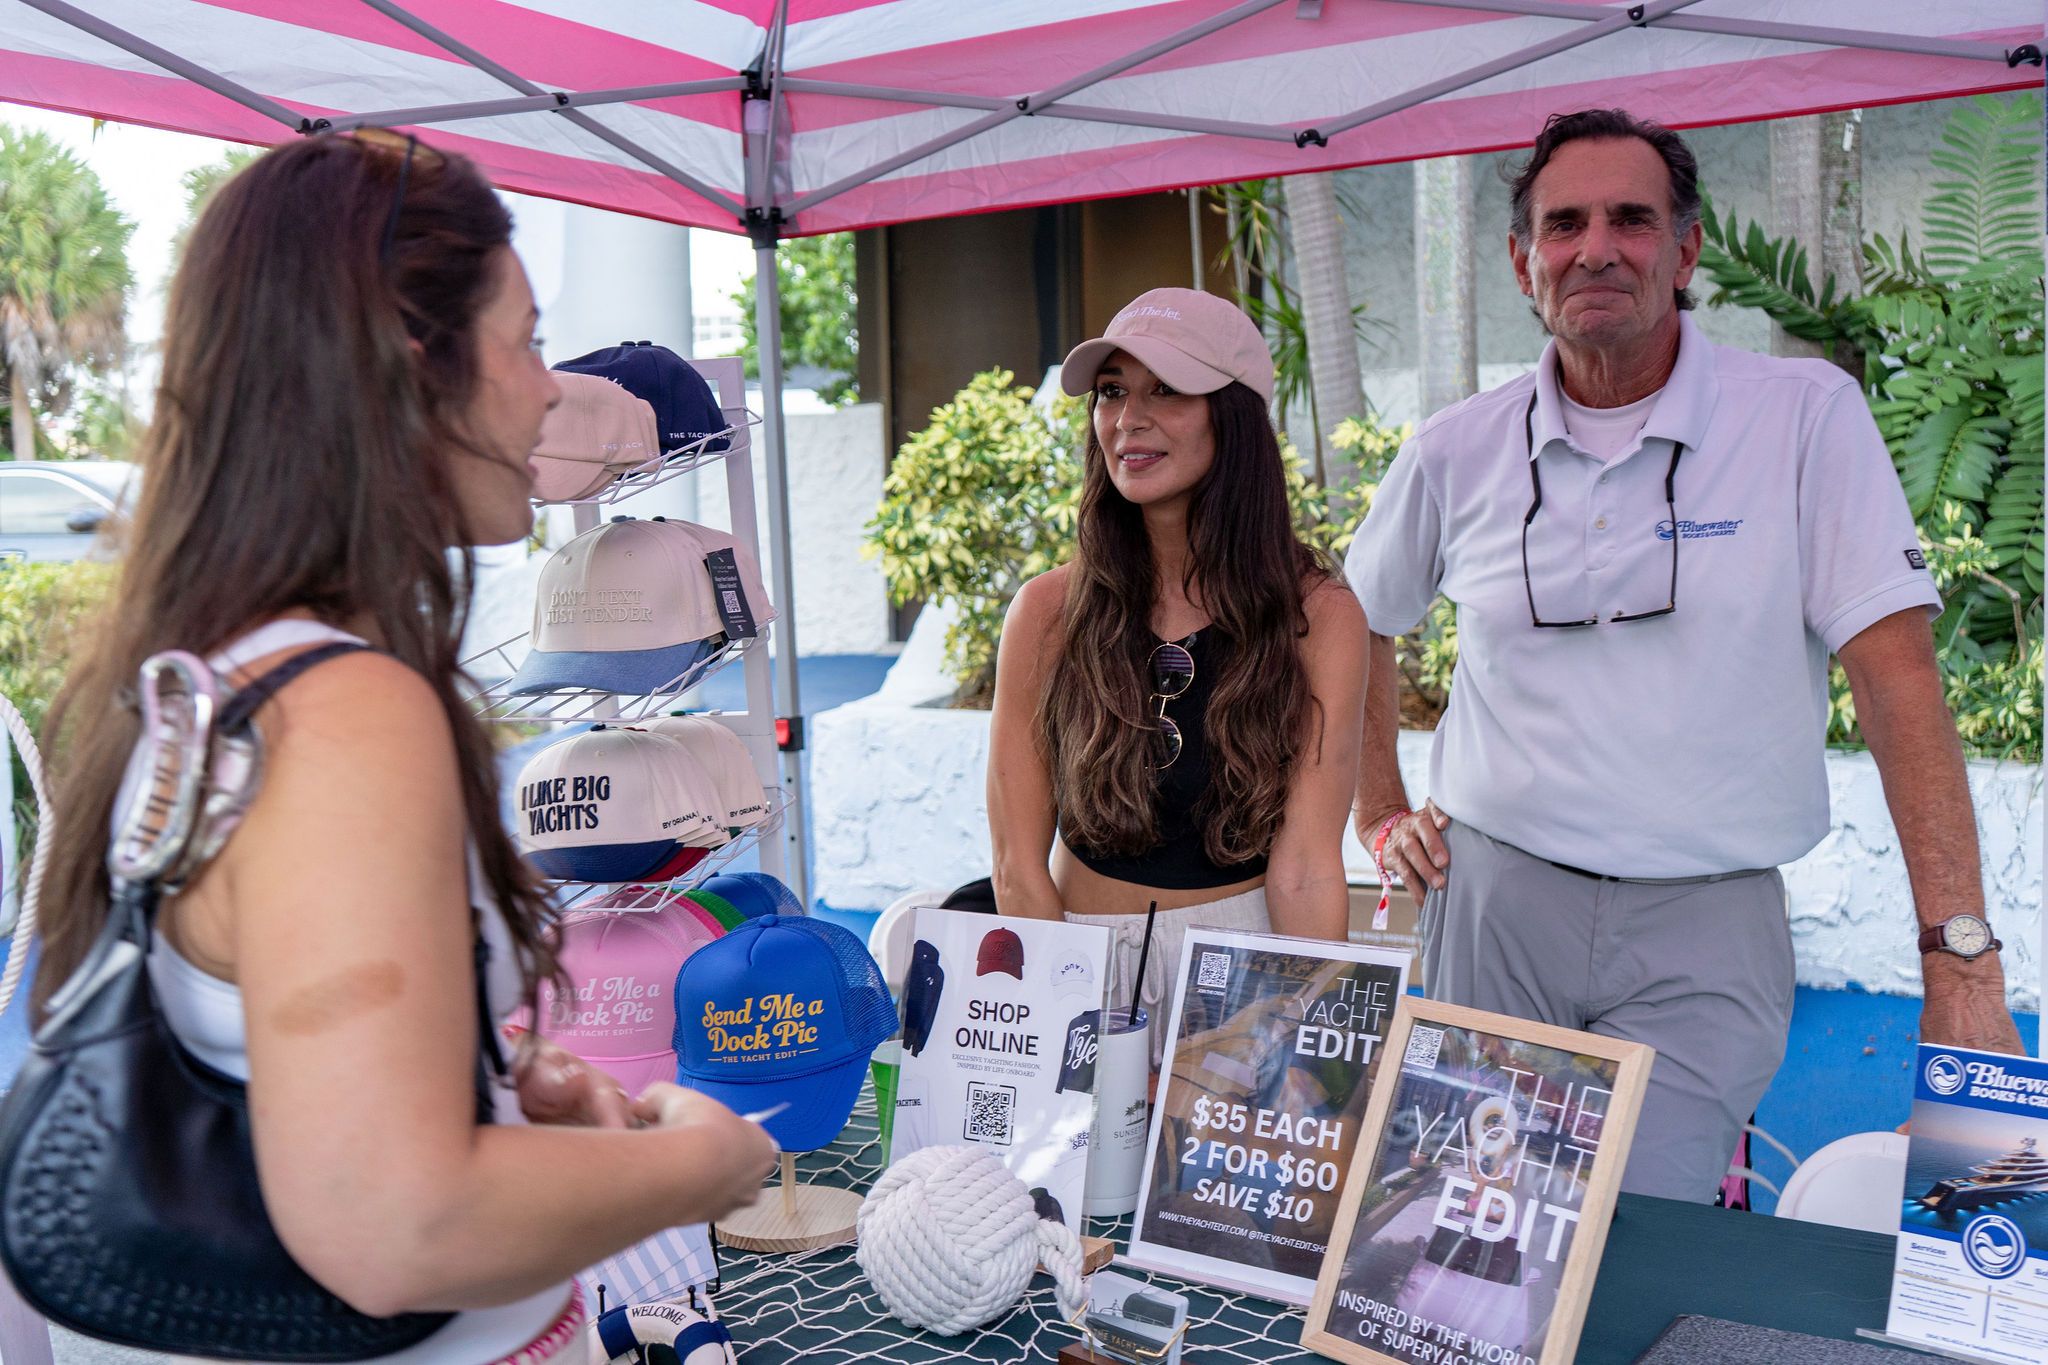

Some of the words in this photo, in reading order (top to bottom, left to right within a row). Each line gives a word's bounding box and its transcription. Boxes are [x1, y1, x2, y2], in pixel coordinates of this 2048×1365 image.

[1140, 306, 1161, 317] The
[1676, 519, 1743, 533] Bluewater
[598, 589, 642, 606] TEXT
[546, 608, 577, 625] JUST
[582, 606, 653, 623] TENDER
[522, 786, 527, 811] I
[529, 777, 566, 809] LIKE
[572, 775, 610, 801] BIG
[529, 803, 599, 836] YACHTS
[662, 820, 672, 830] BY
[729, 810, 739, 818] BY
[602, 976, 645, 1002] Me
[647, 983, 661, 998] a
[1336, 977, 1390, 1007] THE
[549, 1001, 611, 1026] Dock
[612, 1001, 655, 1025] Pic
[702, 997, 753, 1028] Send
[759, 993, 805, 1023] Me
[807, 999, 824, 1016] a
[967, 999, 1030, 1025] SHOP
[1300, 998, 1387, 1032] YACHT
[561, 1029, 578, 1037] THE
[581, 1029, 609, 1037] YACHT
[613, 1028, 635, 1036] EDIT
[707, 1024, 772, 1052] Dock
[772, 1020, 818, 1047] Pic
[955, 1027, 1039, 1056] ONLINE
[1295, 1025, 1382, 1065] EDIT
[741, 1053, 771, 1062] YACHT
[775, 1050, 798, 1060] EDIT
[952, 1054, 983, 1063] EXCLUSIVE
[984, 1057, 1014, 1067] YACHTING
[956, 1062, 983, 1071] INSPIRED
[992, 1066, 1005, 1074] LIFE
[1005, 1069, 1036, 1077] ONBOARD
[1500, 1066, 1613, 1145] THE
[1968, 1086, 2017, 1102] BOOKS
[2016, 1093, 2028, 1105] &
[1191, 1094, 1248, 1133] $35
[1254, 1108, 1343, 1150] EACH
[1181, 1137, 1200, 1165] 2
[1206, 1140, 1270, 1179] FOR
[1274, 1150, 1339, 1192] $60
[1415, 1104, 1598, 1202] YACHT
[1192, 1177, 1264, 1213] SAVE
[1263, 1190, 1314, 1223] $10
[1158, 1210, 1248, 1237] WWW.THEYACHTEDIT.COM
[1432, 1174, 1580, 1263] EDIT
[631, 1305, 687, 1326] WELCOME
[1338, 1289, 1407, 1328] INSPIRED
[1409, 1315, 1433, 1338] BY
[1436, 1324, 1468, 1351] THE
[1358, 1319, 1382, 1340] OF
